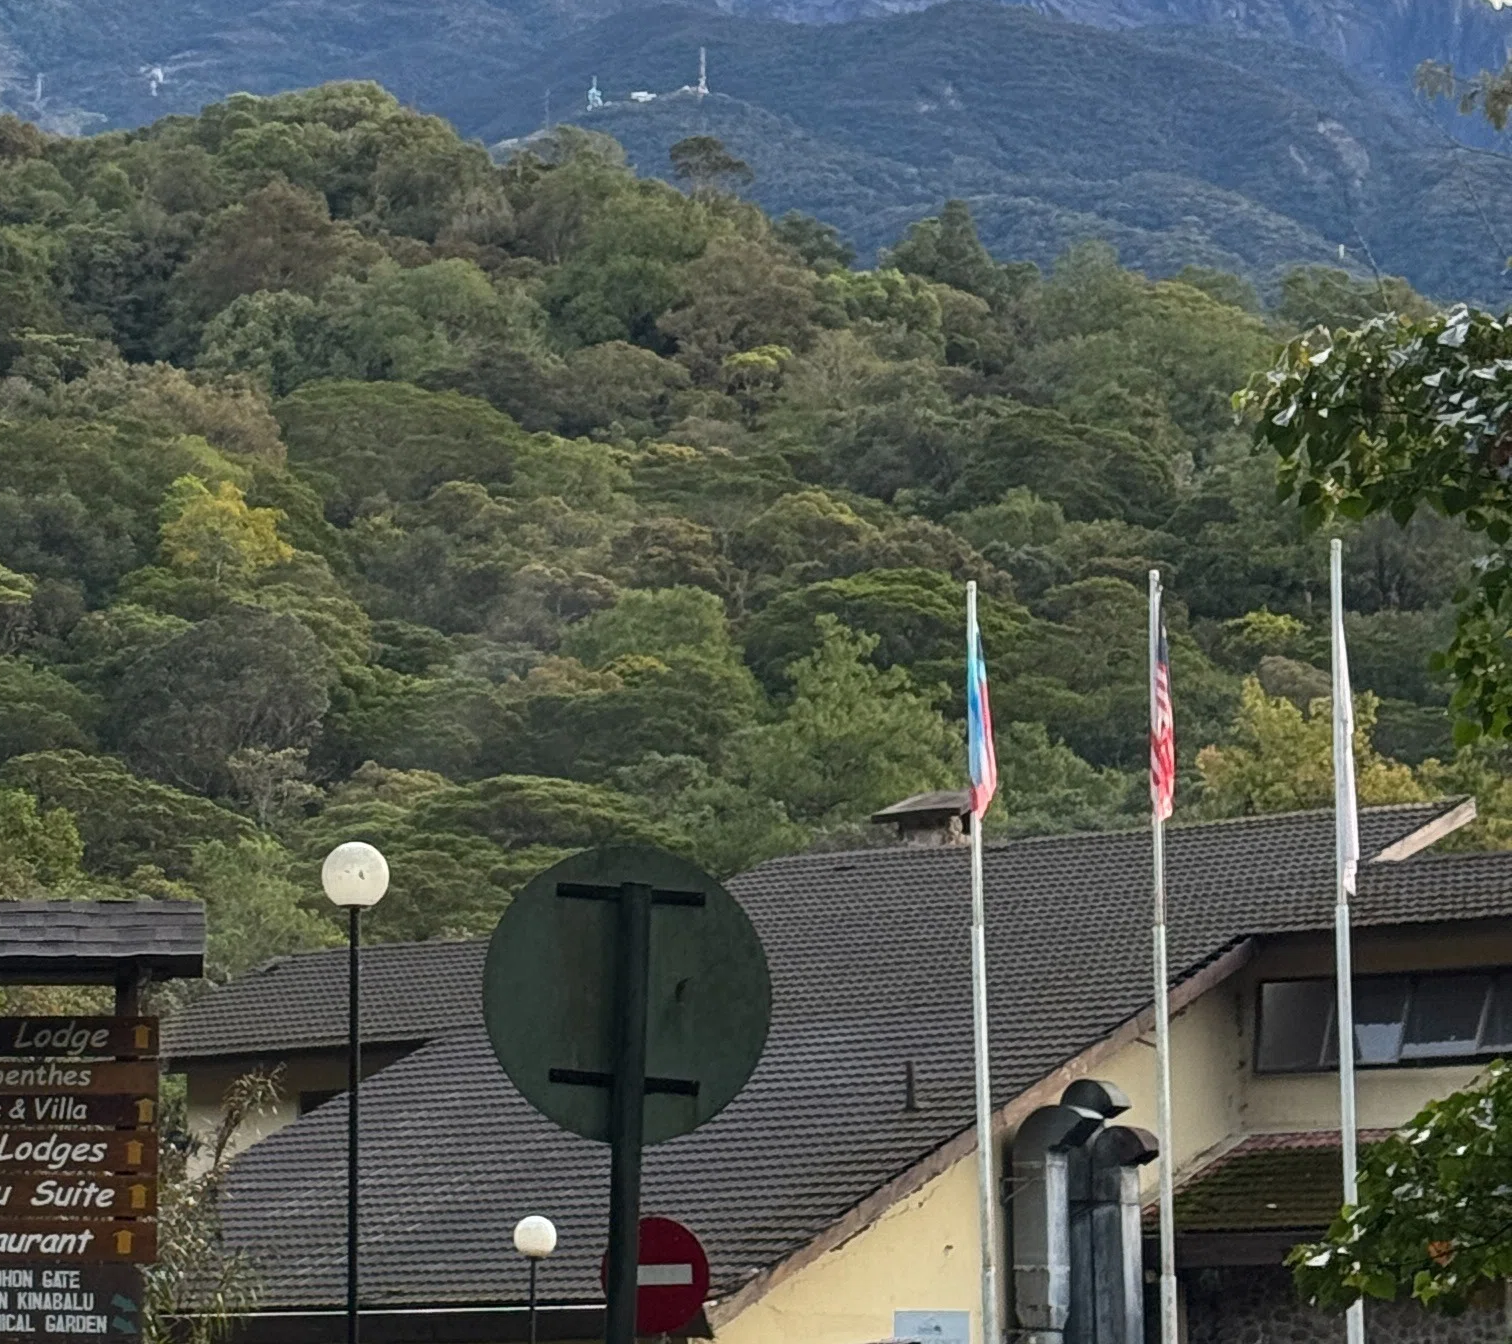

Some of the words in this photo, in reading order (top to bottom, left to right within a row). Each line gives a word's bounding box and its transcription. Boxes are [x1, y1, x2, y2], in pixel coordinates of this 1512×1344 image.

[14, 1021, 110, 1055] Lodge
[8, 1098, 26, 1120] &
[34, 1097, 87, 1120] Villa
[30, 1180, 116, 1208] Suite
[41, 1270, 81, 1289] GATE
[17, 1292, 94, 1311] KINABALU
[45, 1315, 108, 1334] GARDEN
